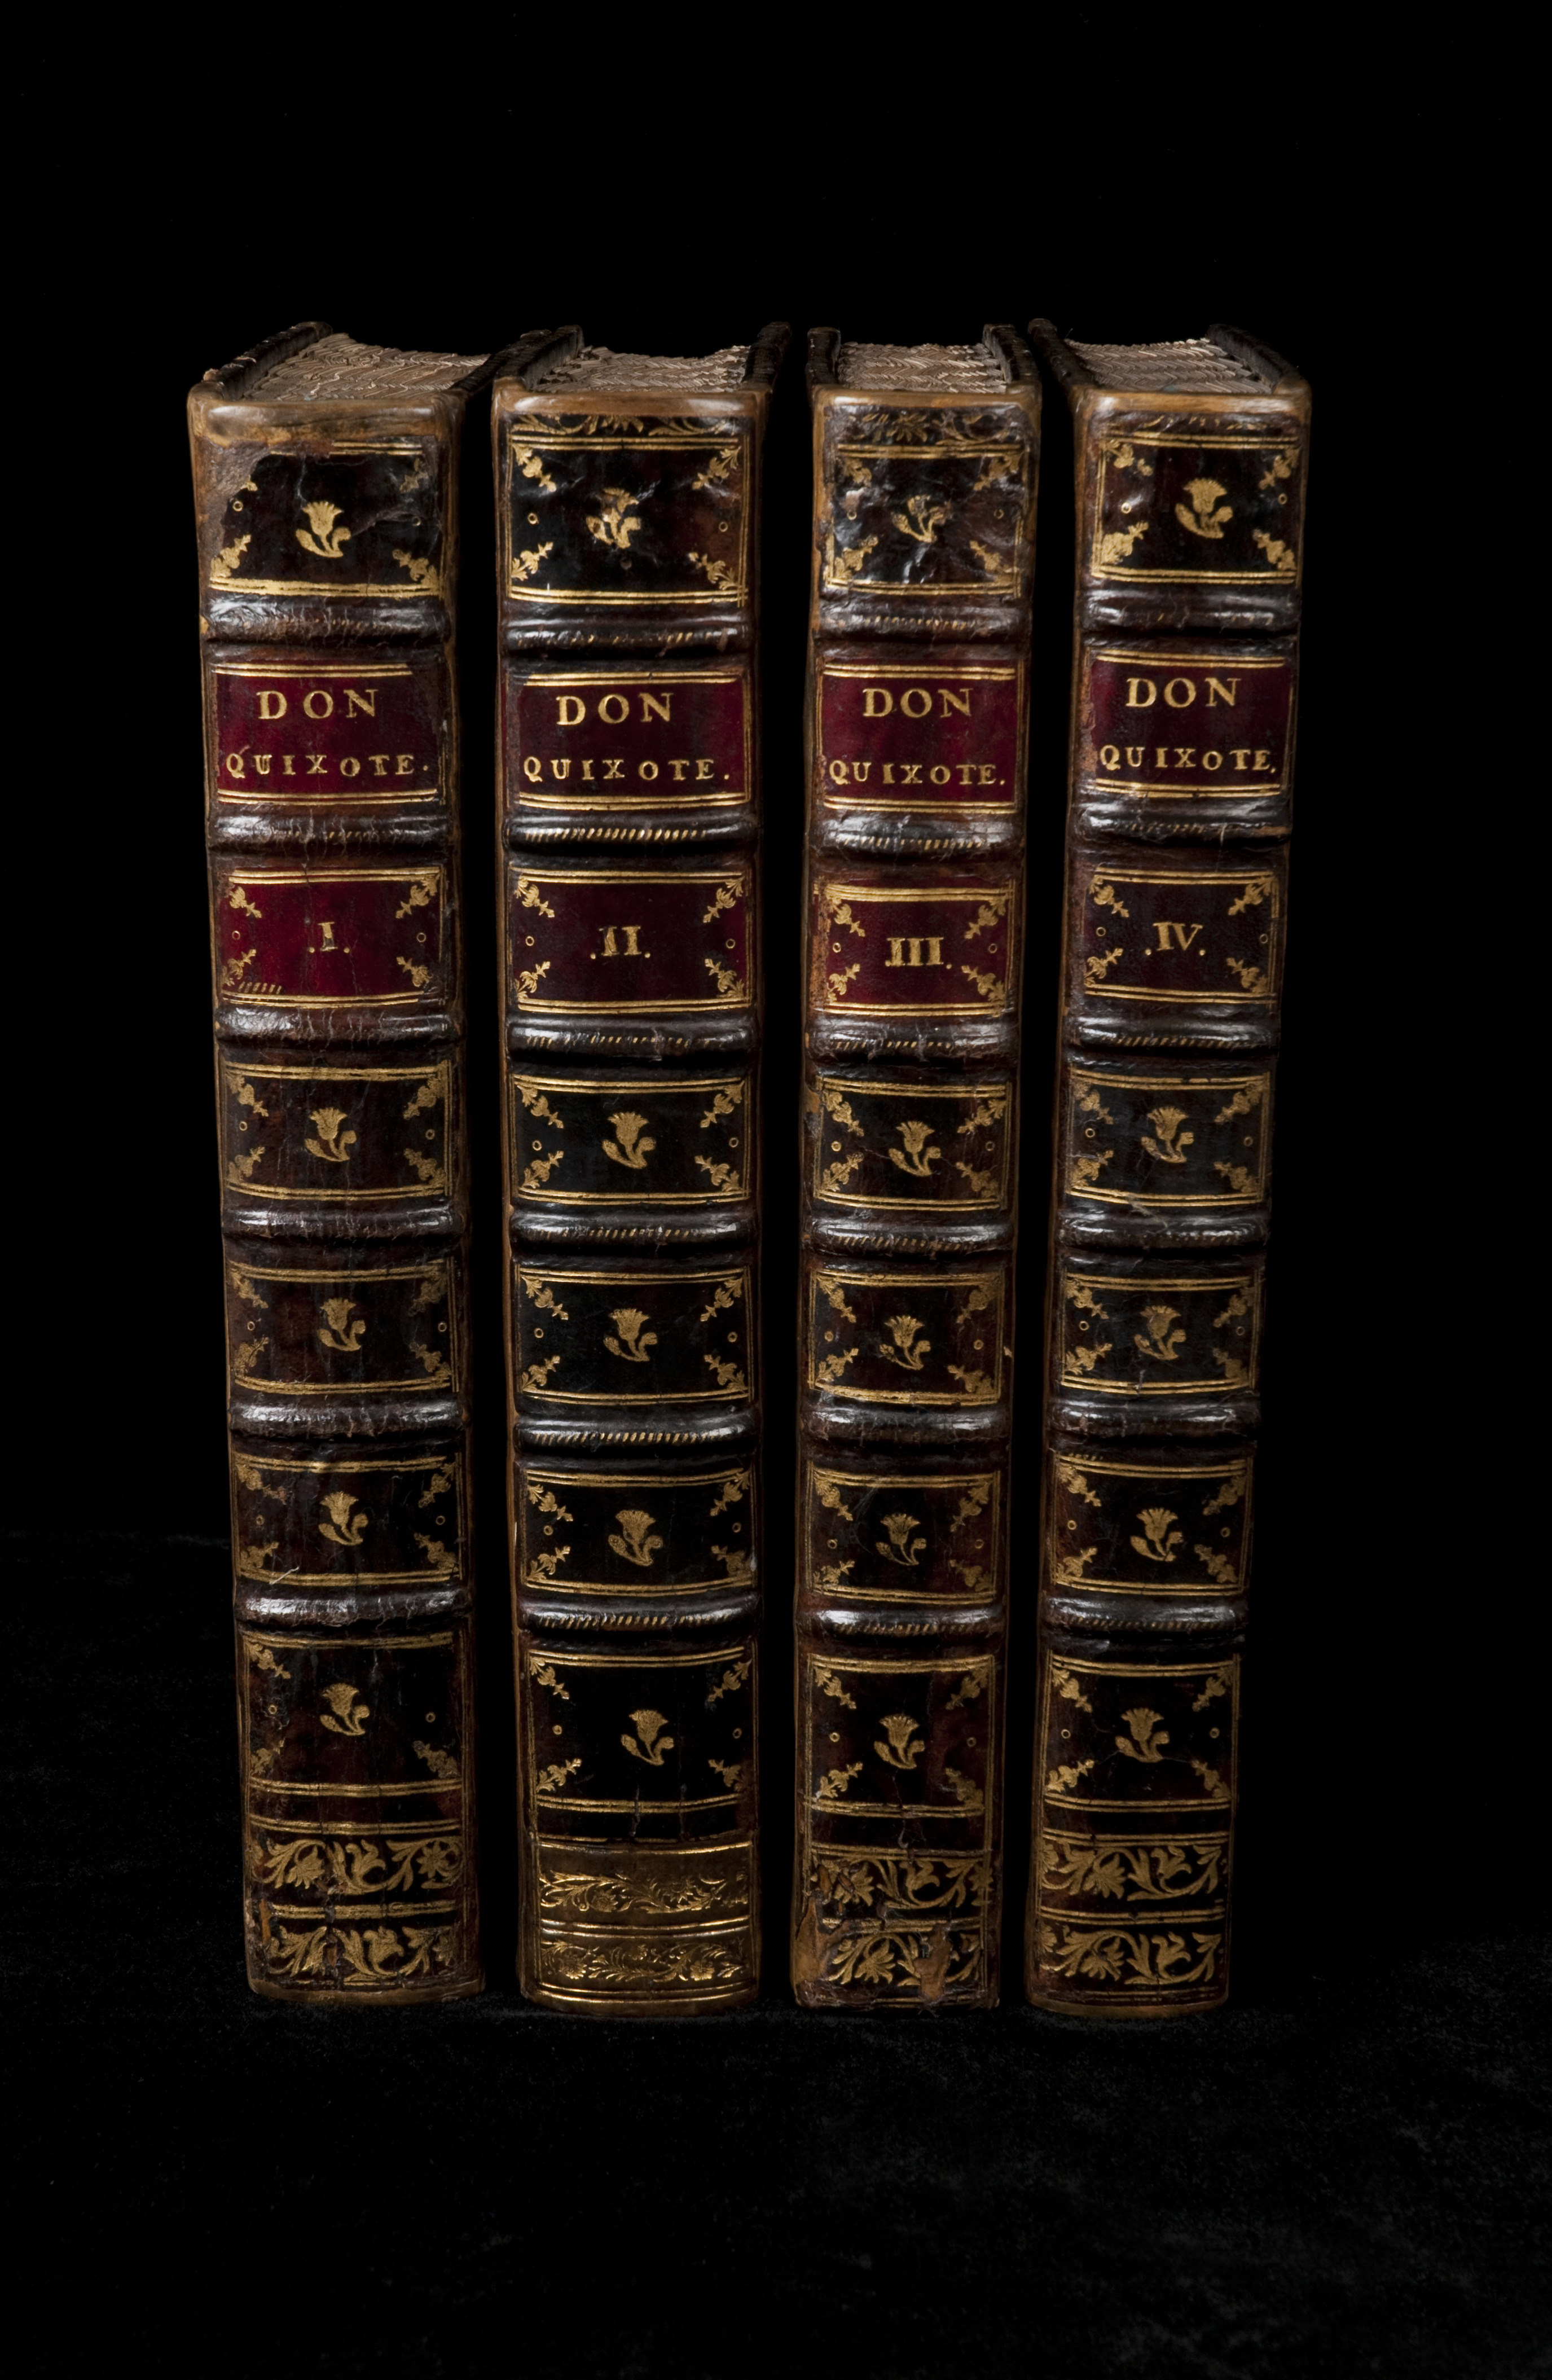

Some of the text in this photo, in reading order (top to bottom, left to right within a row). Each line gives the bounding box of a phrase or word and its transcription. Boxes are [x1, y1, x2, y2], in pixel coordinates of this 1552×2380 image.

[256, 689, 379, 719] DON
[862, 688, 974, 718] DON
[1126, 678, 1241, 708] DON
[556, 693, 674, 726] DON
[226, 754, 428, 779] QUIXOTE.
[523, 756, 729, 783] QUIXOTE.
[829, 760, 1005, 785] QUIXOTE.
[1100, 745, 1276, 774] QUIXOTE.
